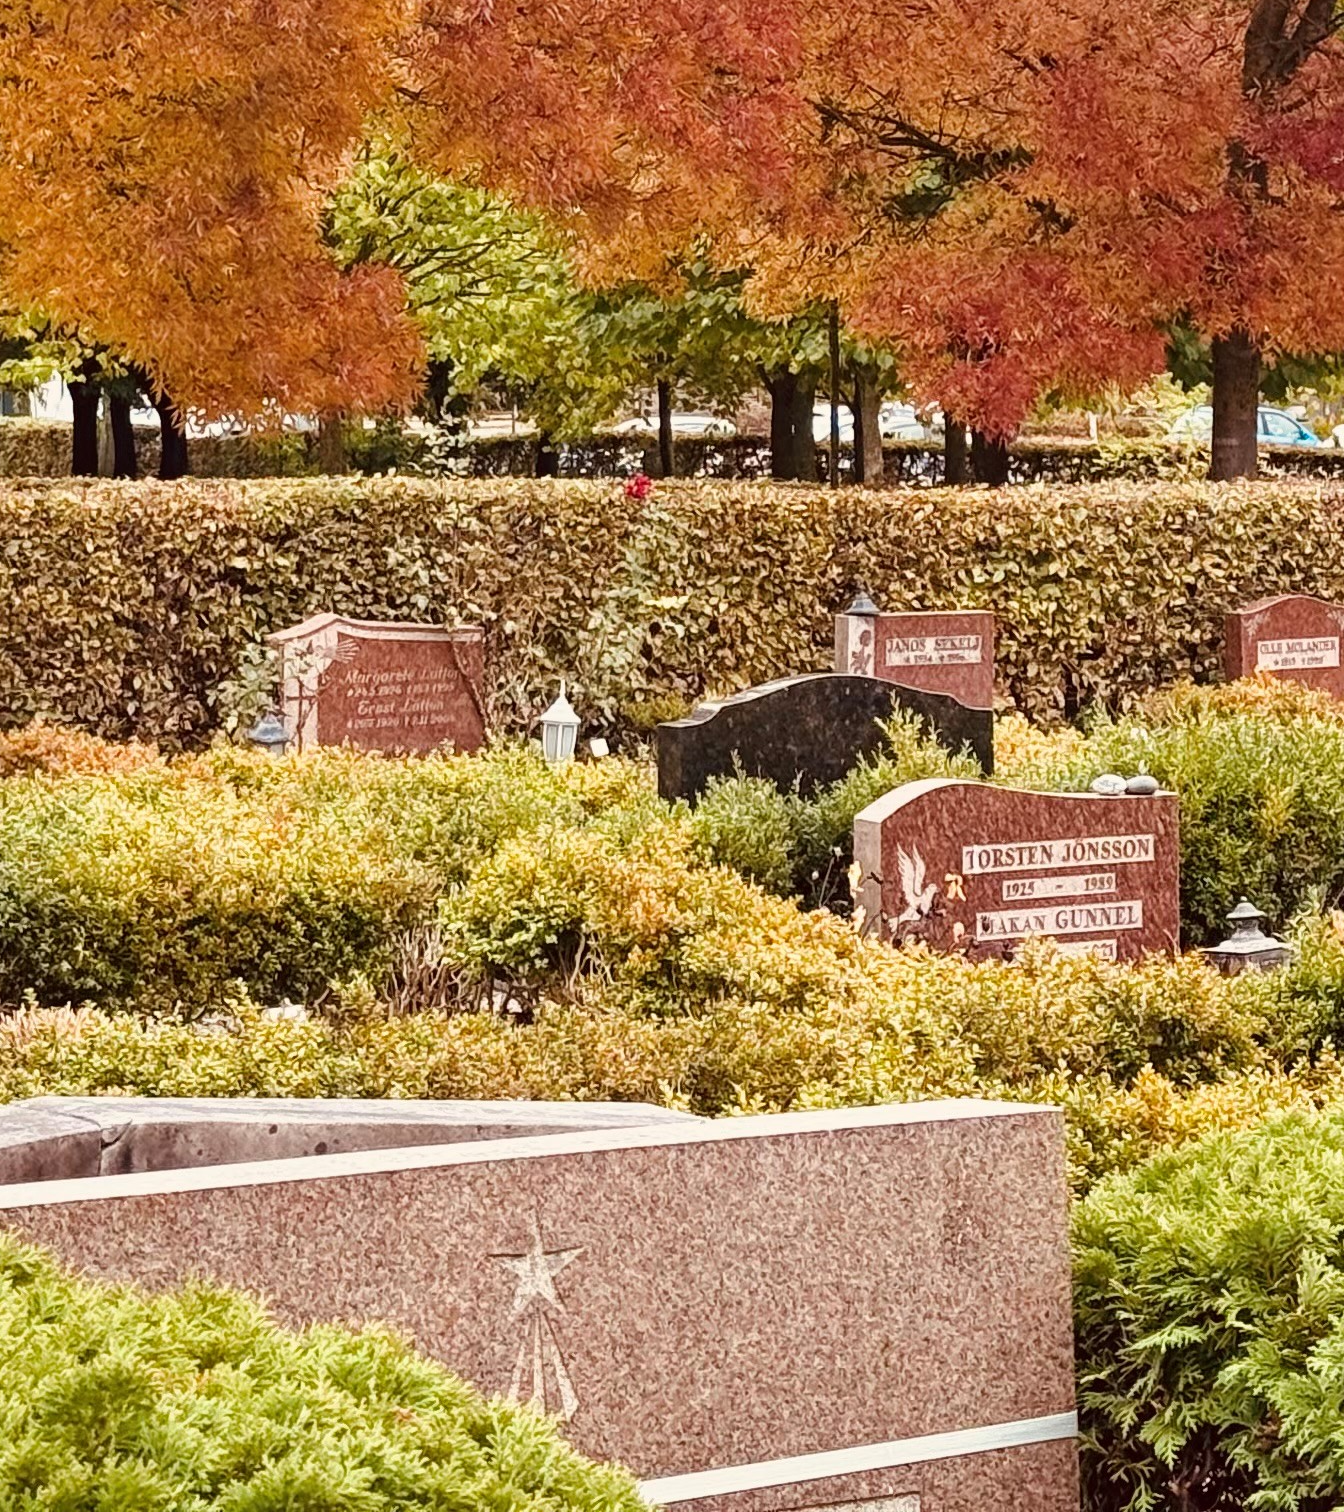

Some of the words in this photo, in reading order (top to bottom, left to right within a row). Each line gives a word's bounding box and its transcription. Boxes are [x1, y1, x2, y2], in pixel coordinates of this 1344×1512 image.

[965, 844, 1053, 870] TORSTEN
[1061, 837, 1151, 864] JÖNSSON
[1055, 905, 1140, 931] GUNNEL
